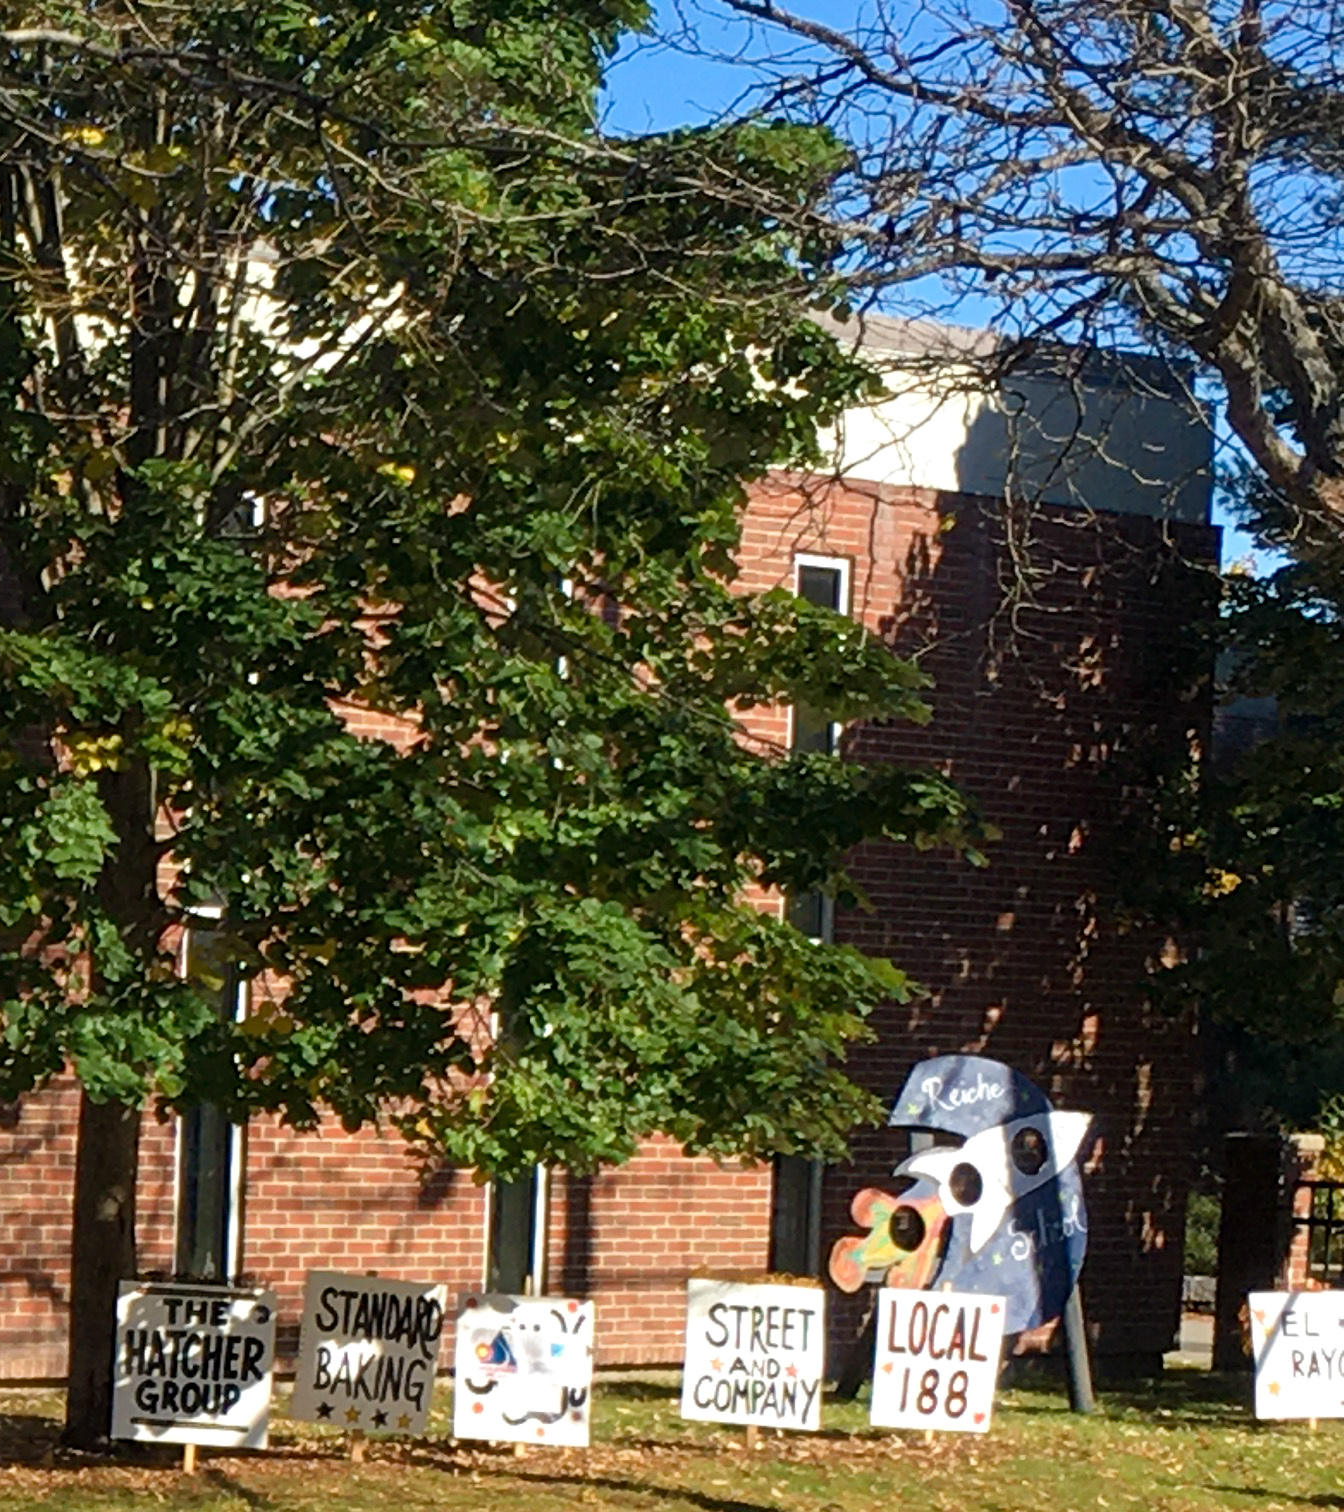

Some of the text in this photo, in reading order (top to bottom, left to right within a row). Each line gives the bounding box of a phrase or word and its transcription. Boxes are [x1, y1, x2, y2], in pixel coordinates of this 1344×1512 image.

[922, 1072, 1006, 1111] Reiche
[163, 1298, 231, 1326] THE
[315, 1287, 444, 1360] STANDARD
[705, 1303, 815, 1354] STREET
[888, 1300, 987, 1362] LOCAL
[1282, 1311, 1320, 1337] EL
[125, 1329, 265, 1381] HATCHER
[313, 1347, 427, 1412] BAKING
[729, 1357, 781, 1380] AND
[136, 1379, 240, 1415] GROUP
[693, 1375, 820, 1425] COMPANY
[899, 1367, 969, 1419] 188
